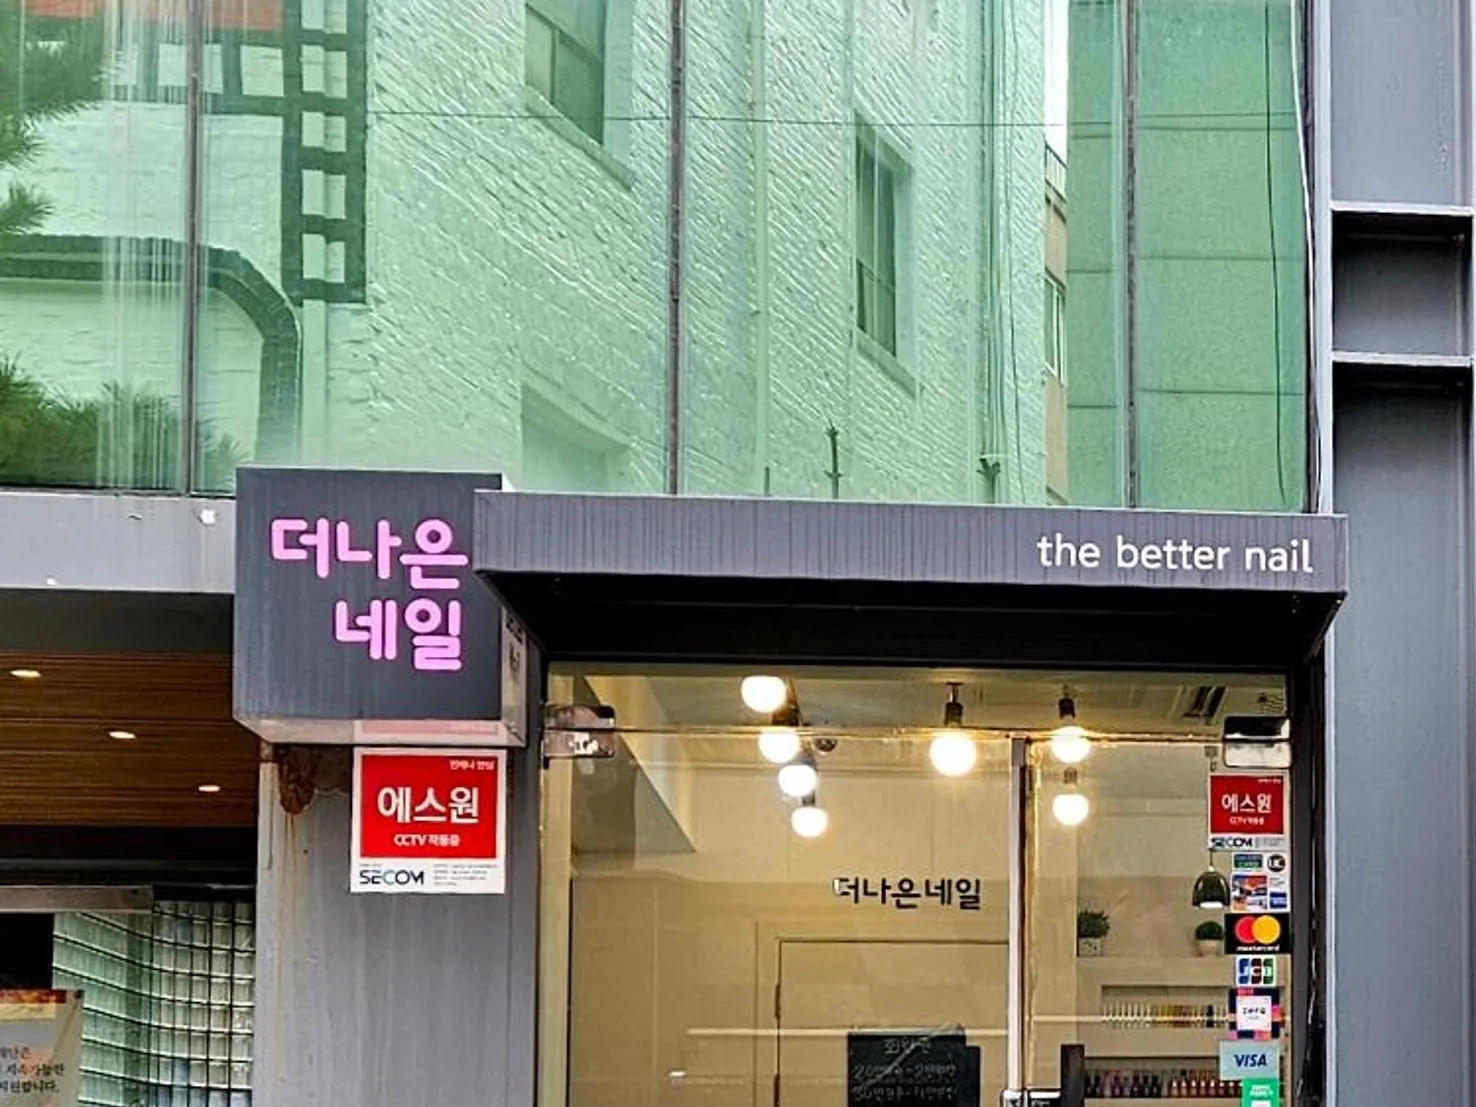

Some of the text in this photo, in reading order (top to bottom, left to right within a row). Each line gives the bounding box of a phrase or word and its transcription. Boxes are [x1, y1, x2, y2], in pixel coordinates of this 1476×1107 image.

[270, 517, 469, 590] 더나은
[1036, 533, 1314, 573] the better nail
[335, 598, 462, 671] 네일
[377, 786, 481, 824] 에스원
[1221, 793, 1272, 814] 에스원
[394, 833, 427, 847] CCTV
[359, 869, 425, 886] SECOM
[834, 877, 981, 911] 더나은네일
[1233, 1053, 1268, 1068] VISA
